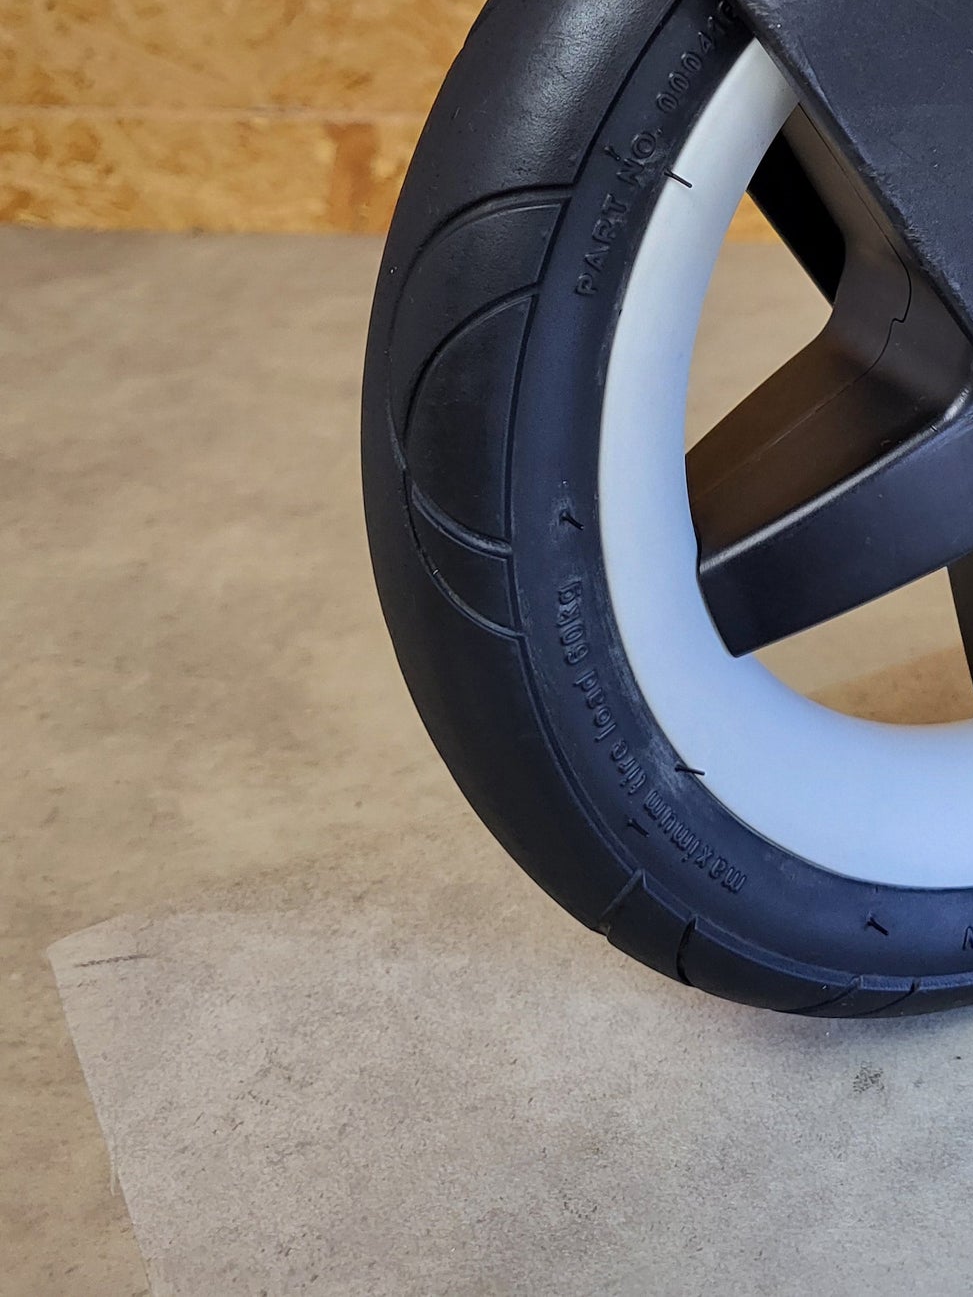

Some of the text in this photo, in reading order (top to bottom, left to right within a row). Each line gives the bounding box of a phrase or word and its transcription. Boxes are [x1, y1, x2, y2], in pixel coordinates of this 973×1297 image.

[572, 192, 629, 297] PART
[615, 128, 663, 189] NO.
[556, 578, 749, 895] maximum tire load 60kg
